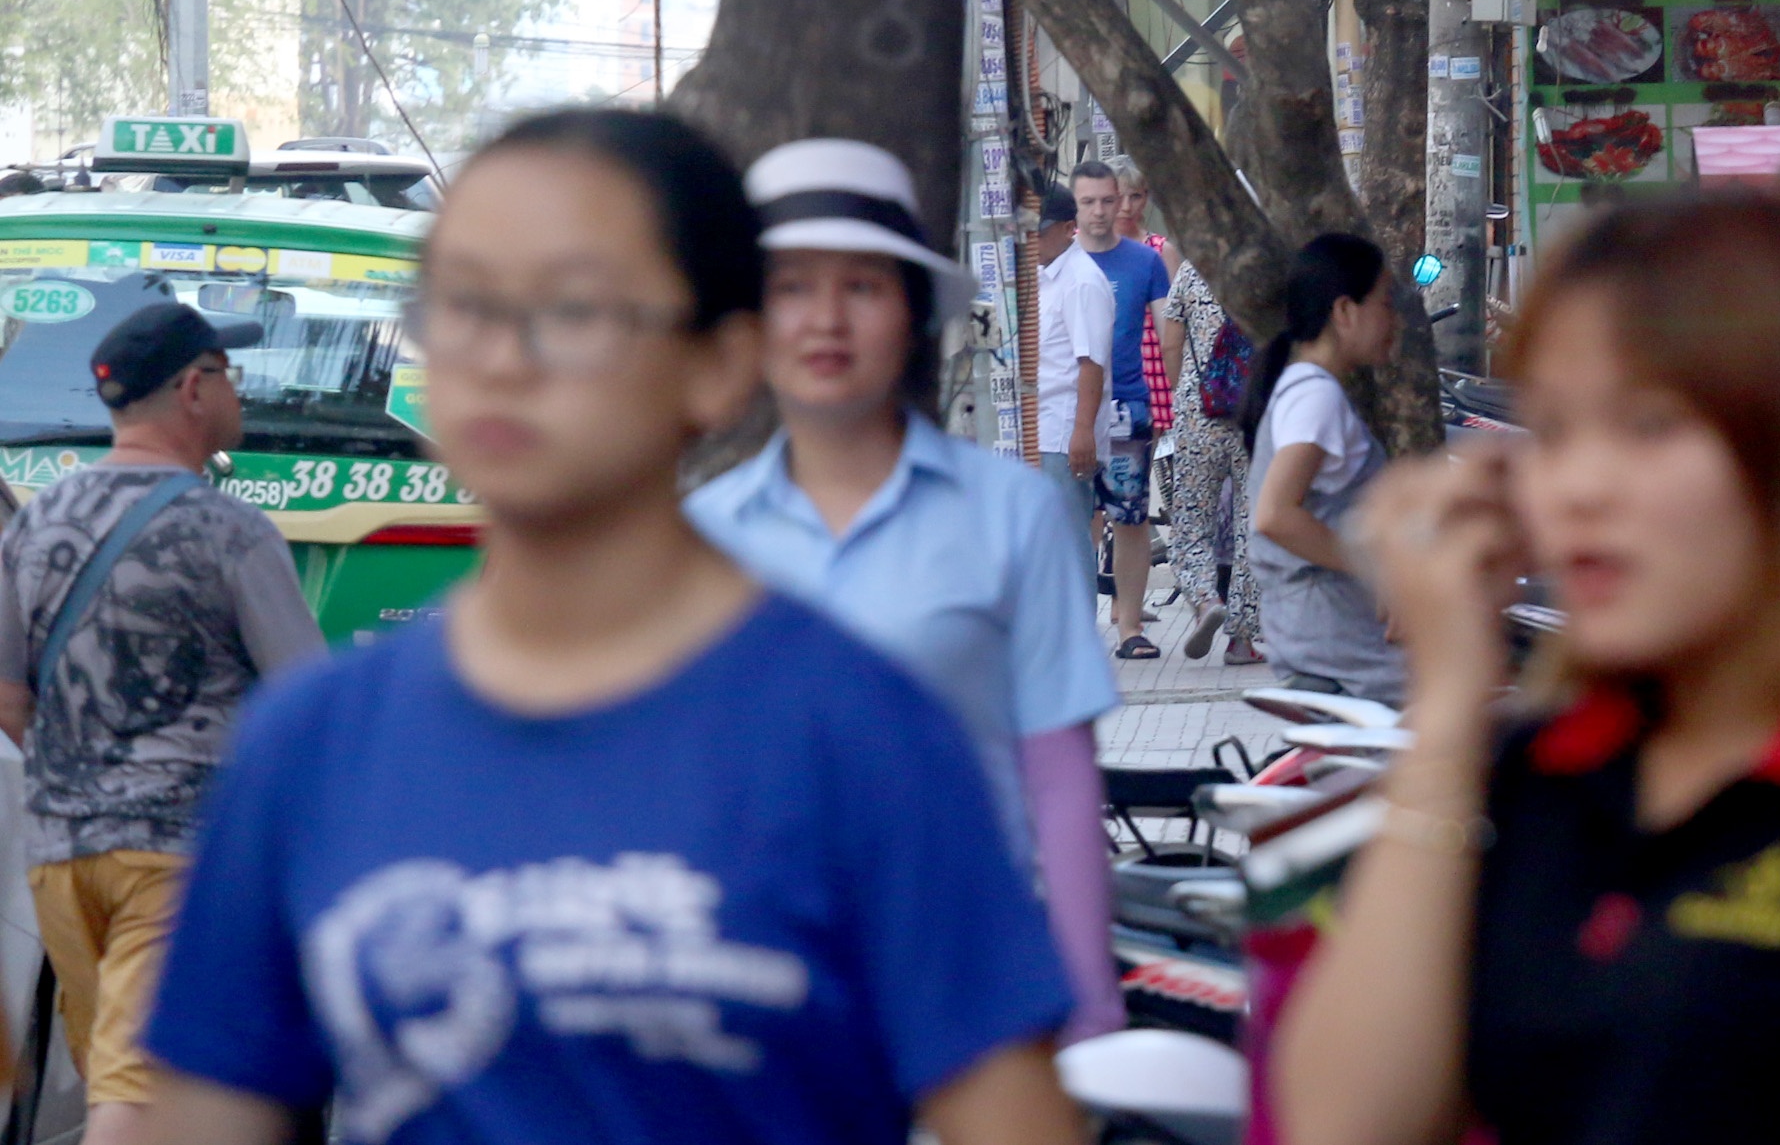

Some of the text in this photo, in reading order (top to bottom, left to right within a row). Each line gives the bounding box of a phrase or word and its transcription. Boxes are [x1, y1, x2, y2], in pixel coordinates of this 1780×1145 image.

[159, 250, 196, 261] VISA
[288, 256, 322, 271] ATM
[13, 289, 79, 314] 5263
[289, 460, 337, 498] 38
[343, 462, 394, 501] 38
[399, 464, 450, 503] 38
